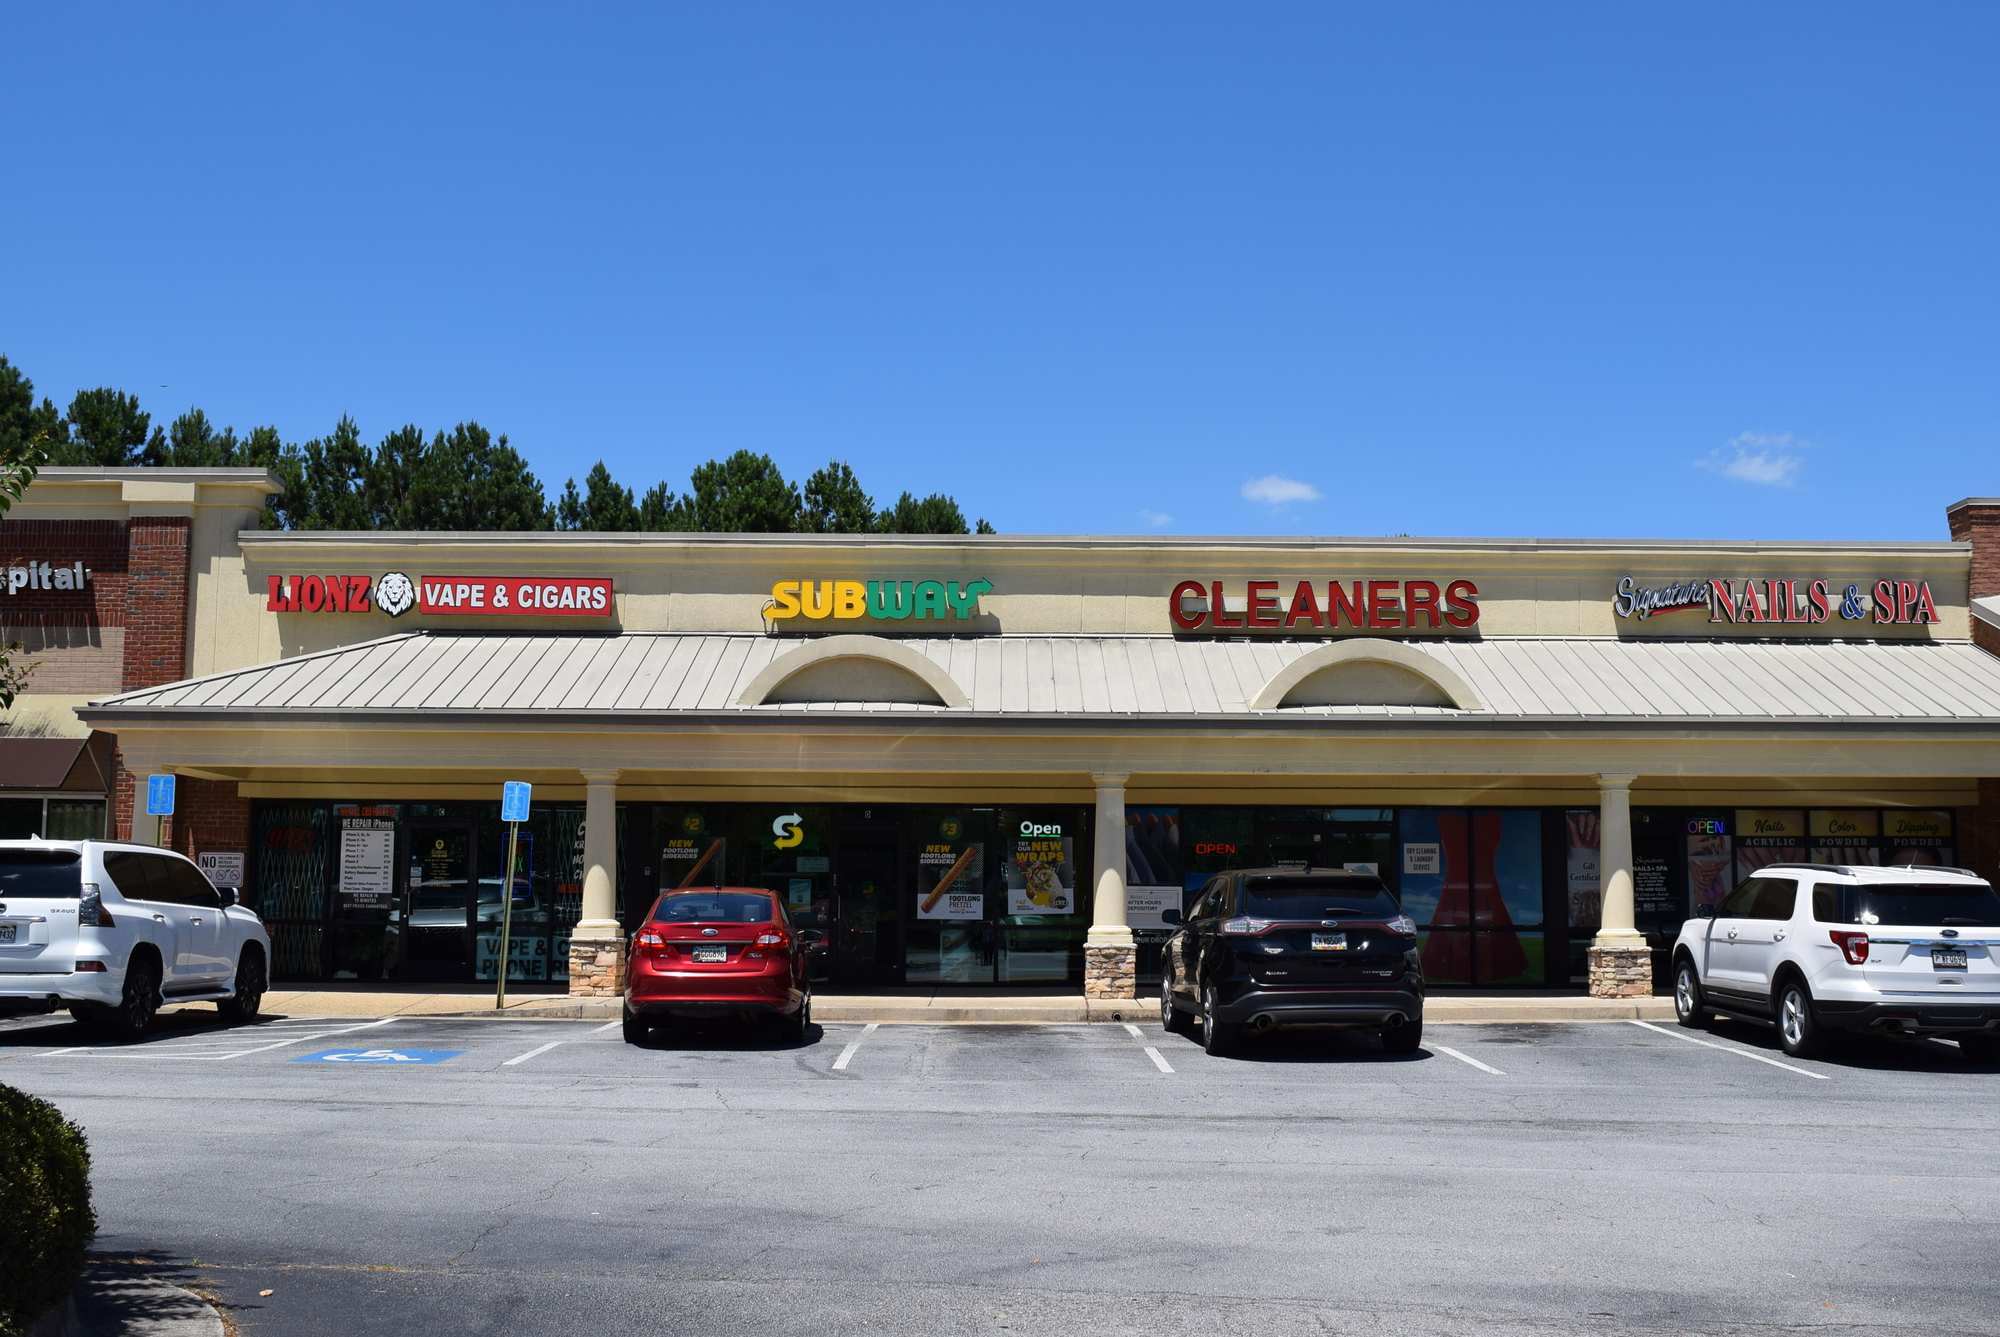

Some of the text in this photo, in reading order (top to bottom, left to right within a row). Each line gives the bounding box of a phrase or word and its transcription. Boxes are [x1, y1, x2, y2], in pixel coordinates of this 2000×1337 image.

[267, 575, 371, 612] LIONZ
[425, 584, 607, 609] VAPE & CIGARS
[764, 577, 994, 620] SUBWAY
[1615, 574, 1941, 624] Signature NAILS & SPA
[1169, 580, 1480, 629] CLEANERS
[352, 819, 371, 829] REPAIR
[1020, 821, 1061, 837] Open
[1688, 820, 1725, 834] OPEN
[1829, 820, 1857, 834] Color
[668, 840, 694, 848] NEW
[926, 844, 951, 853] NEW
[1031, 841, 1062, 851] NEW
[1744, 838, 1796, 847] ACRYLIC
[1819, 838, 1868, 847] POWDER
[1893, 838, 1943, 848] POWDER
[1196, 843, 1236, 855] OPEN
[201, 856, 216, 868] NO
[1016, 852, 1065, 863] WRAPS
[1570, 872, 1600, 881] Certificat
